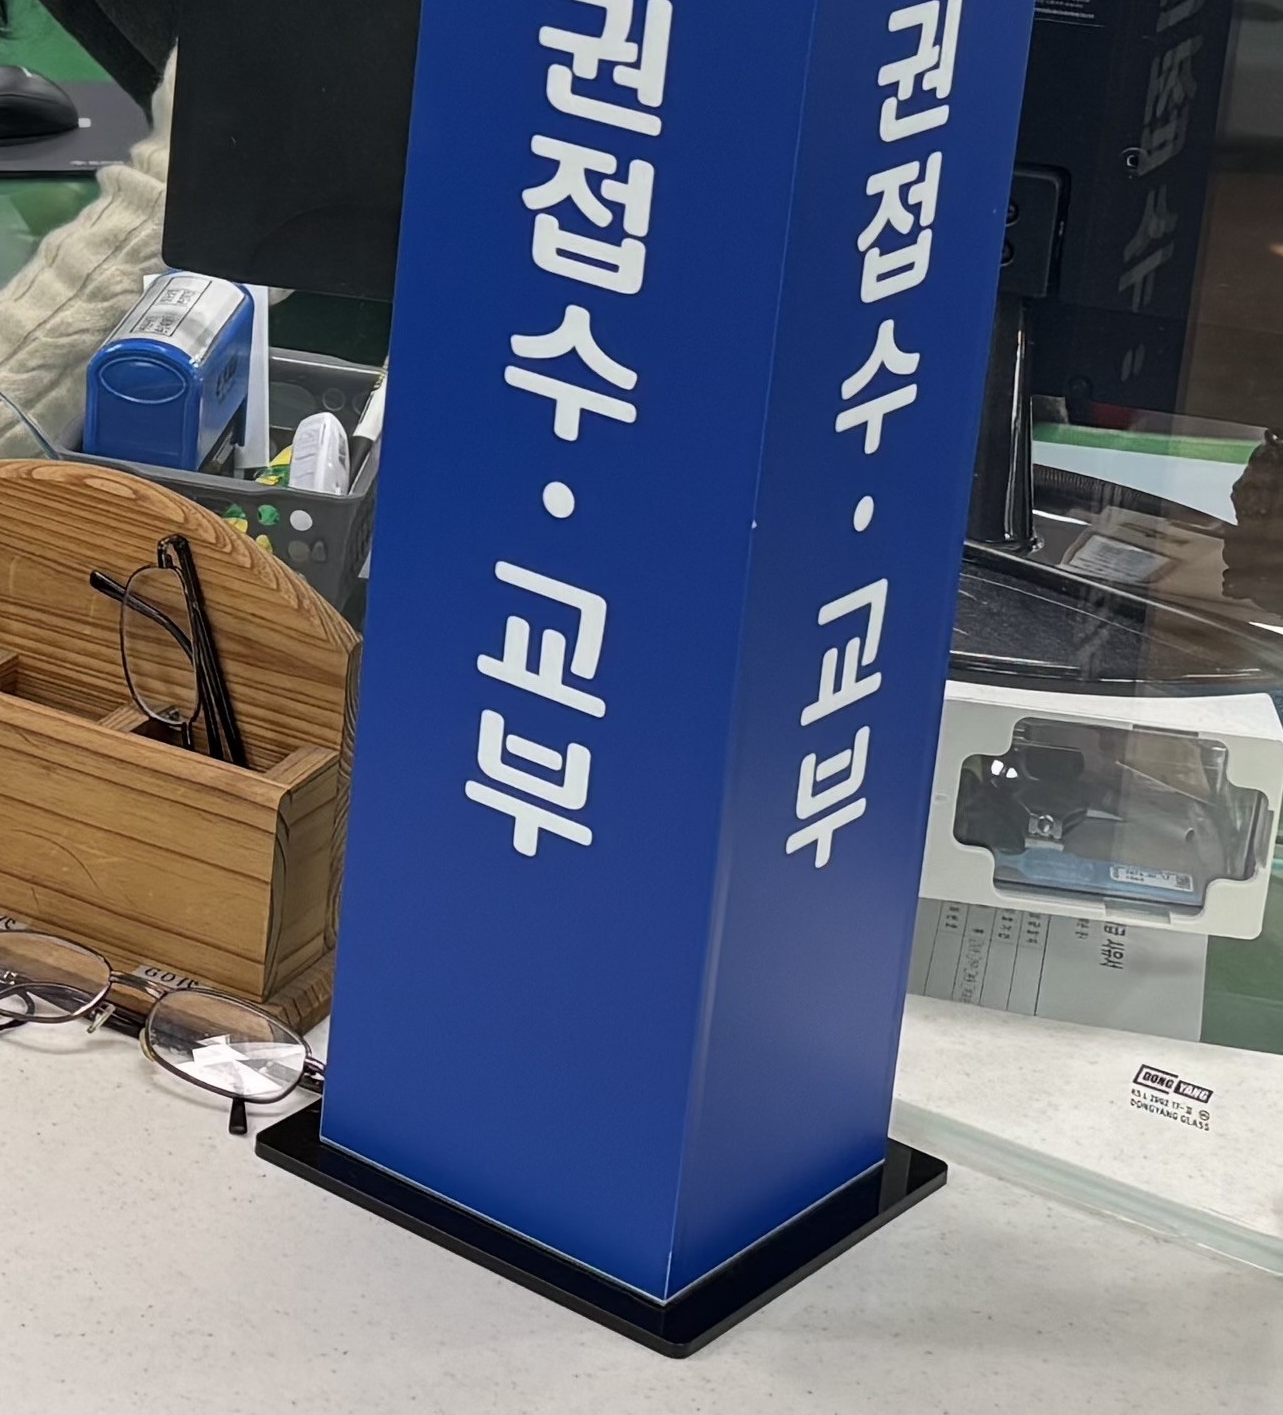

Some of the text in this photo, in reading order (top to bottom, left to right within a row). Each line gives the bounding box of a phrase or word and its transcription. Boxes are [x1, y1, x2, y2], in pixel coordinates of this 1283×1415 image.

[1100, 938, 1125, 970] 사유서
[1142, 1071, 1211, 1101] DONG YANG
[1130, 1098, 1210, 1132] DONGYANG GLASS
